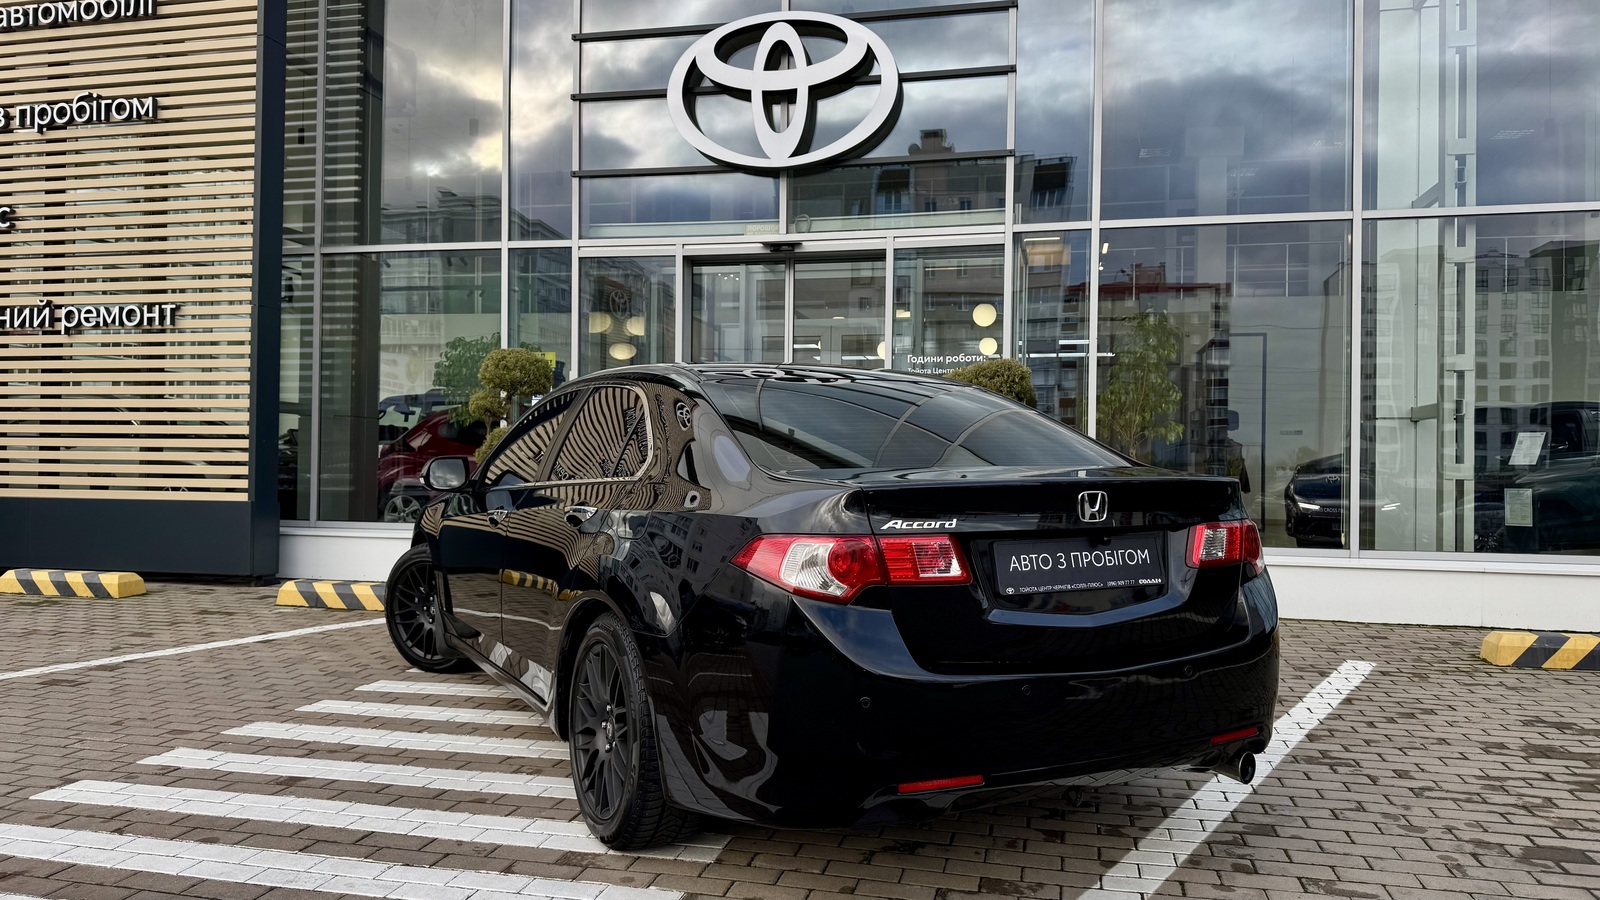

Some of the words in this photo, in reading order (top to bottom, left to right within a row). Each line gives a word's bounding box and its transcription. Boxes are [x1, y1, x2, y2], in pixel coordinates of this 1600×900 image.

[16, 92, 153, 133] пробігом
[61, 304, 177, 335] ремонт
[907, 354, 944, 365] Години
[945, 353, 987, 364] роботи:
[880, 518, 957, 530] Accord
[1009, 553, 1053, 572] АВТО
[1056, 552, 1067, 569] З
[1070, 549, 1151, 568] ПРОБІГОМ
